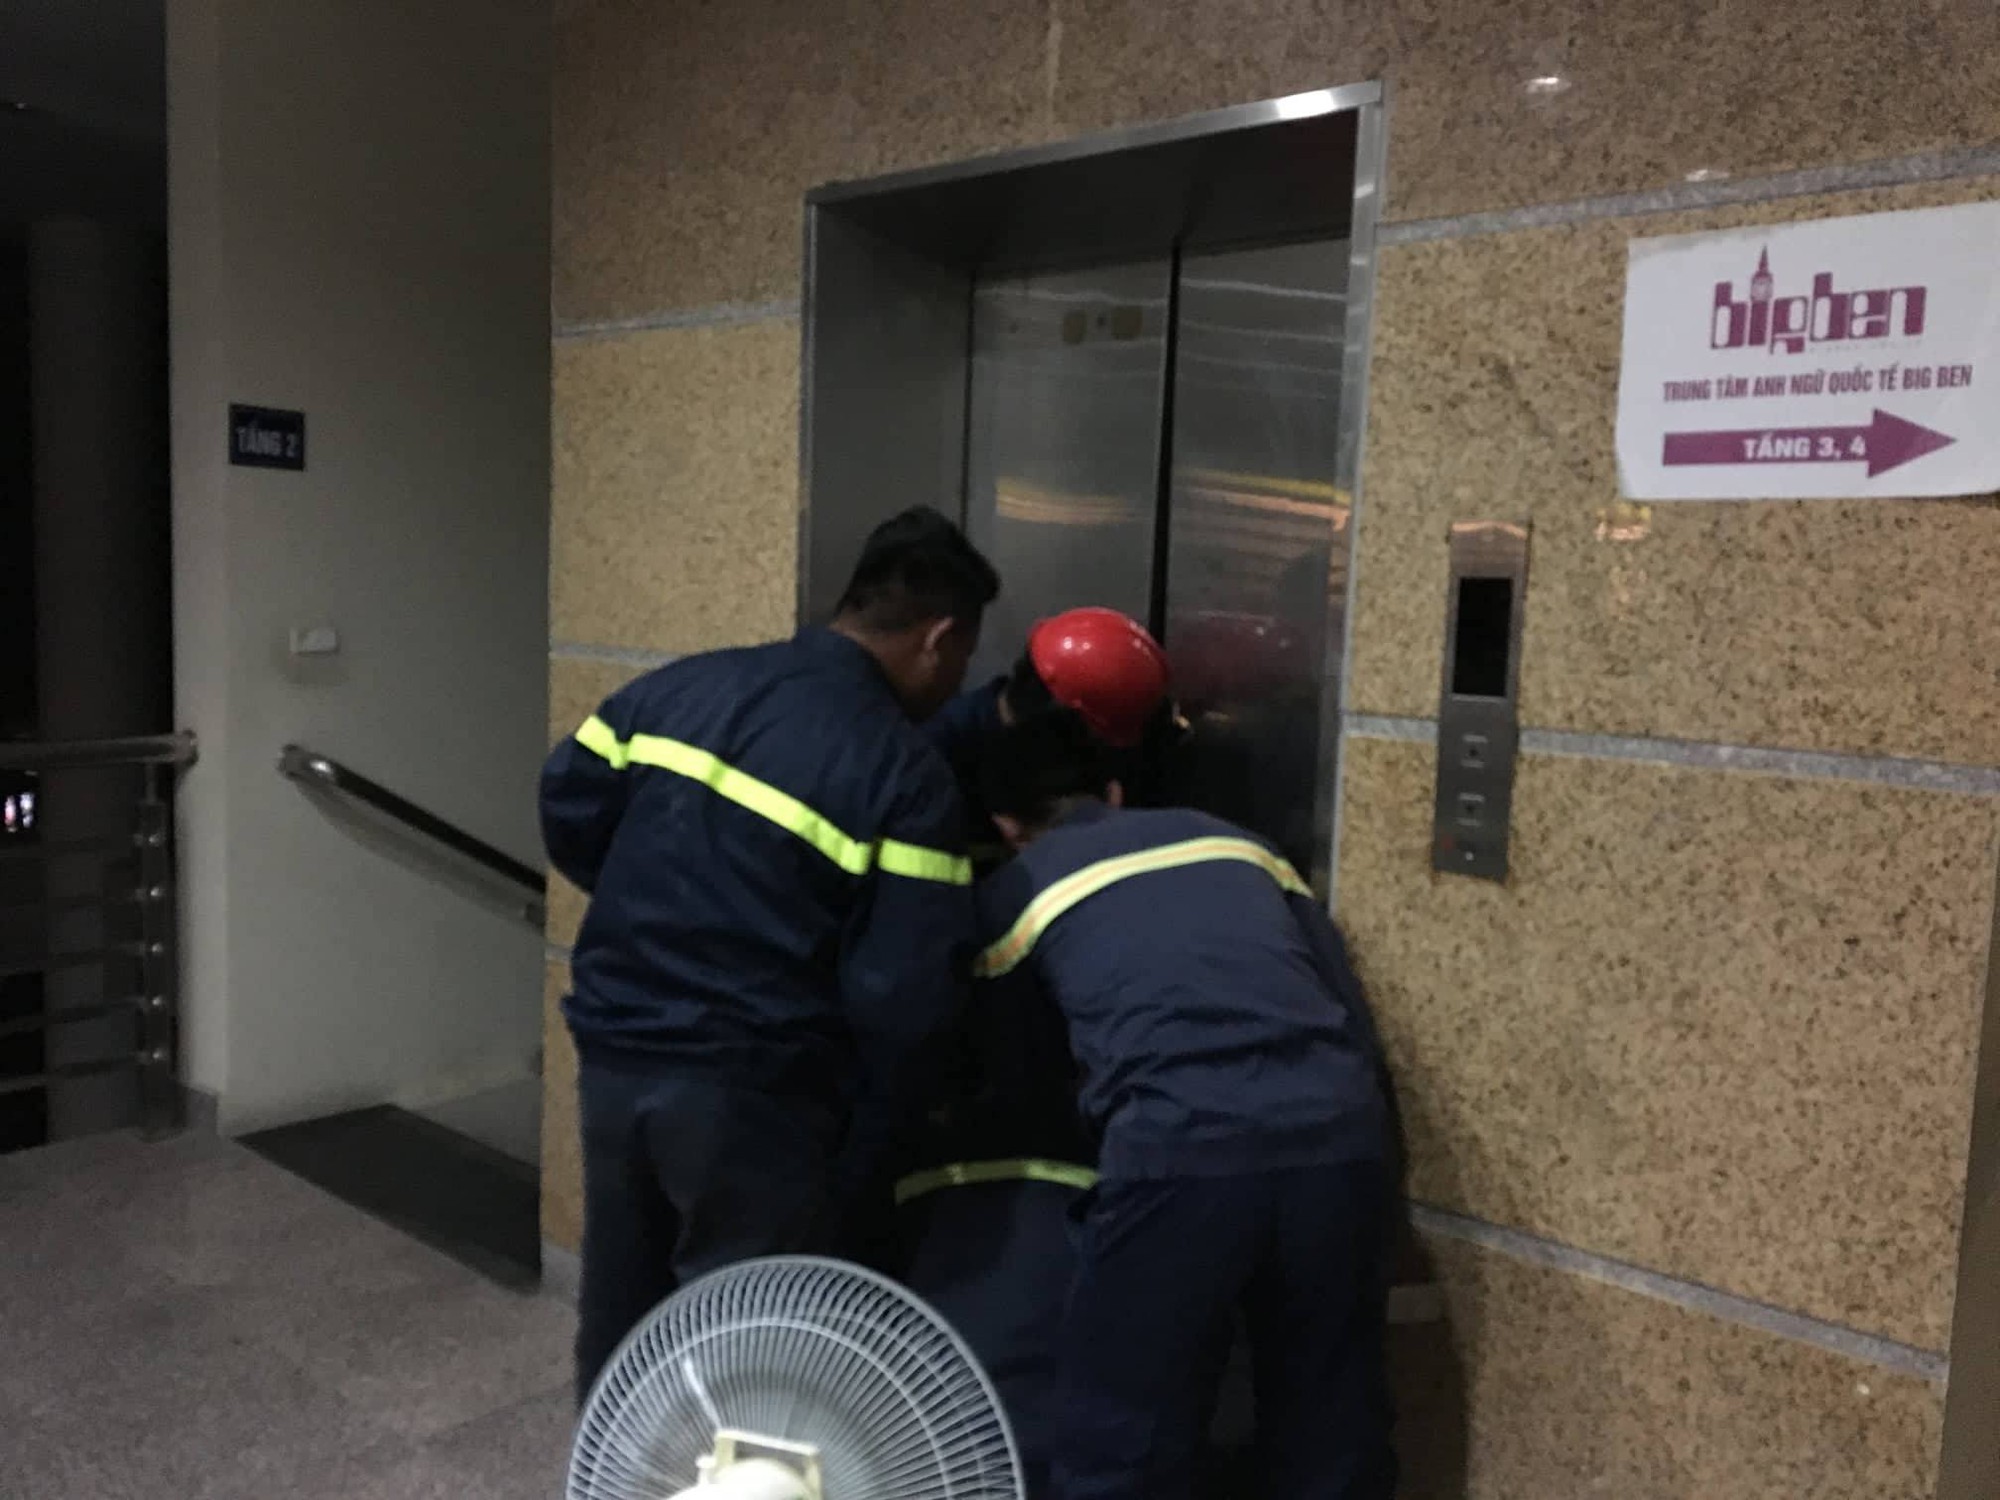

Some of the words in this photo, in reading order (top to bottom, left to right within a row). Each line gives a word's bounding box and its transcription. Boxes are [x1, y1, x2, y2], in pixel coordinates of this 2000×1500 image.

[1711, 247, 1927, 354] bigben
[1663, 381, 1711, 401] TRUNG
[1716, 374, 1748, 400] TÂM
[1753, 376, 1787, 397] ANH
[1829, 363, 1873, 395] QUỐC
[1879, 362, 1899, 390] TẾ
[1902, 367, 1932, 389] BIG
[1937, 365, 1973, 388] BEN
[286, 433, 295, 457] 2
[1816, 437, 1842, 460] 3,
[1850, 435, 1867, 456] 4
